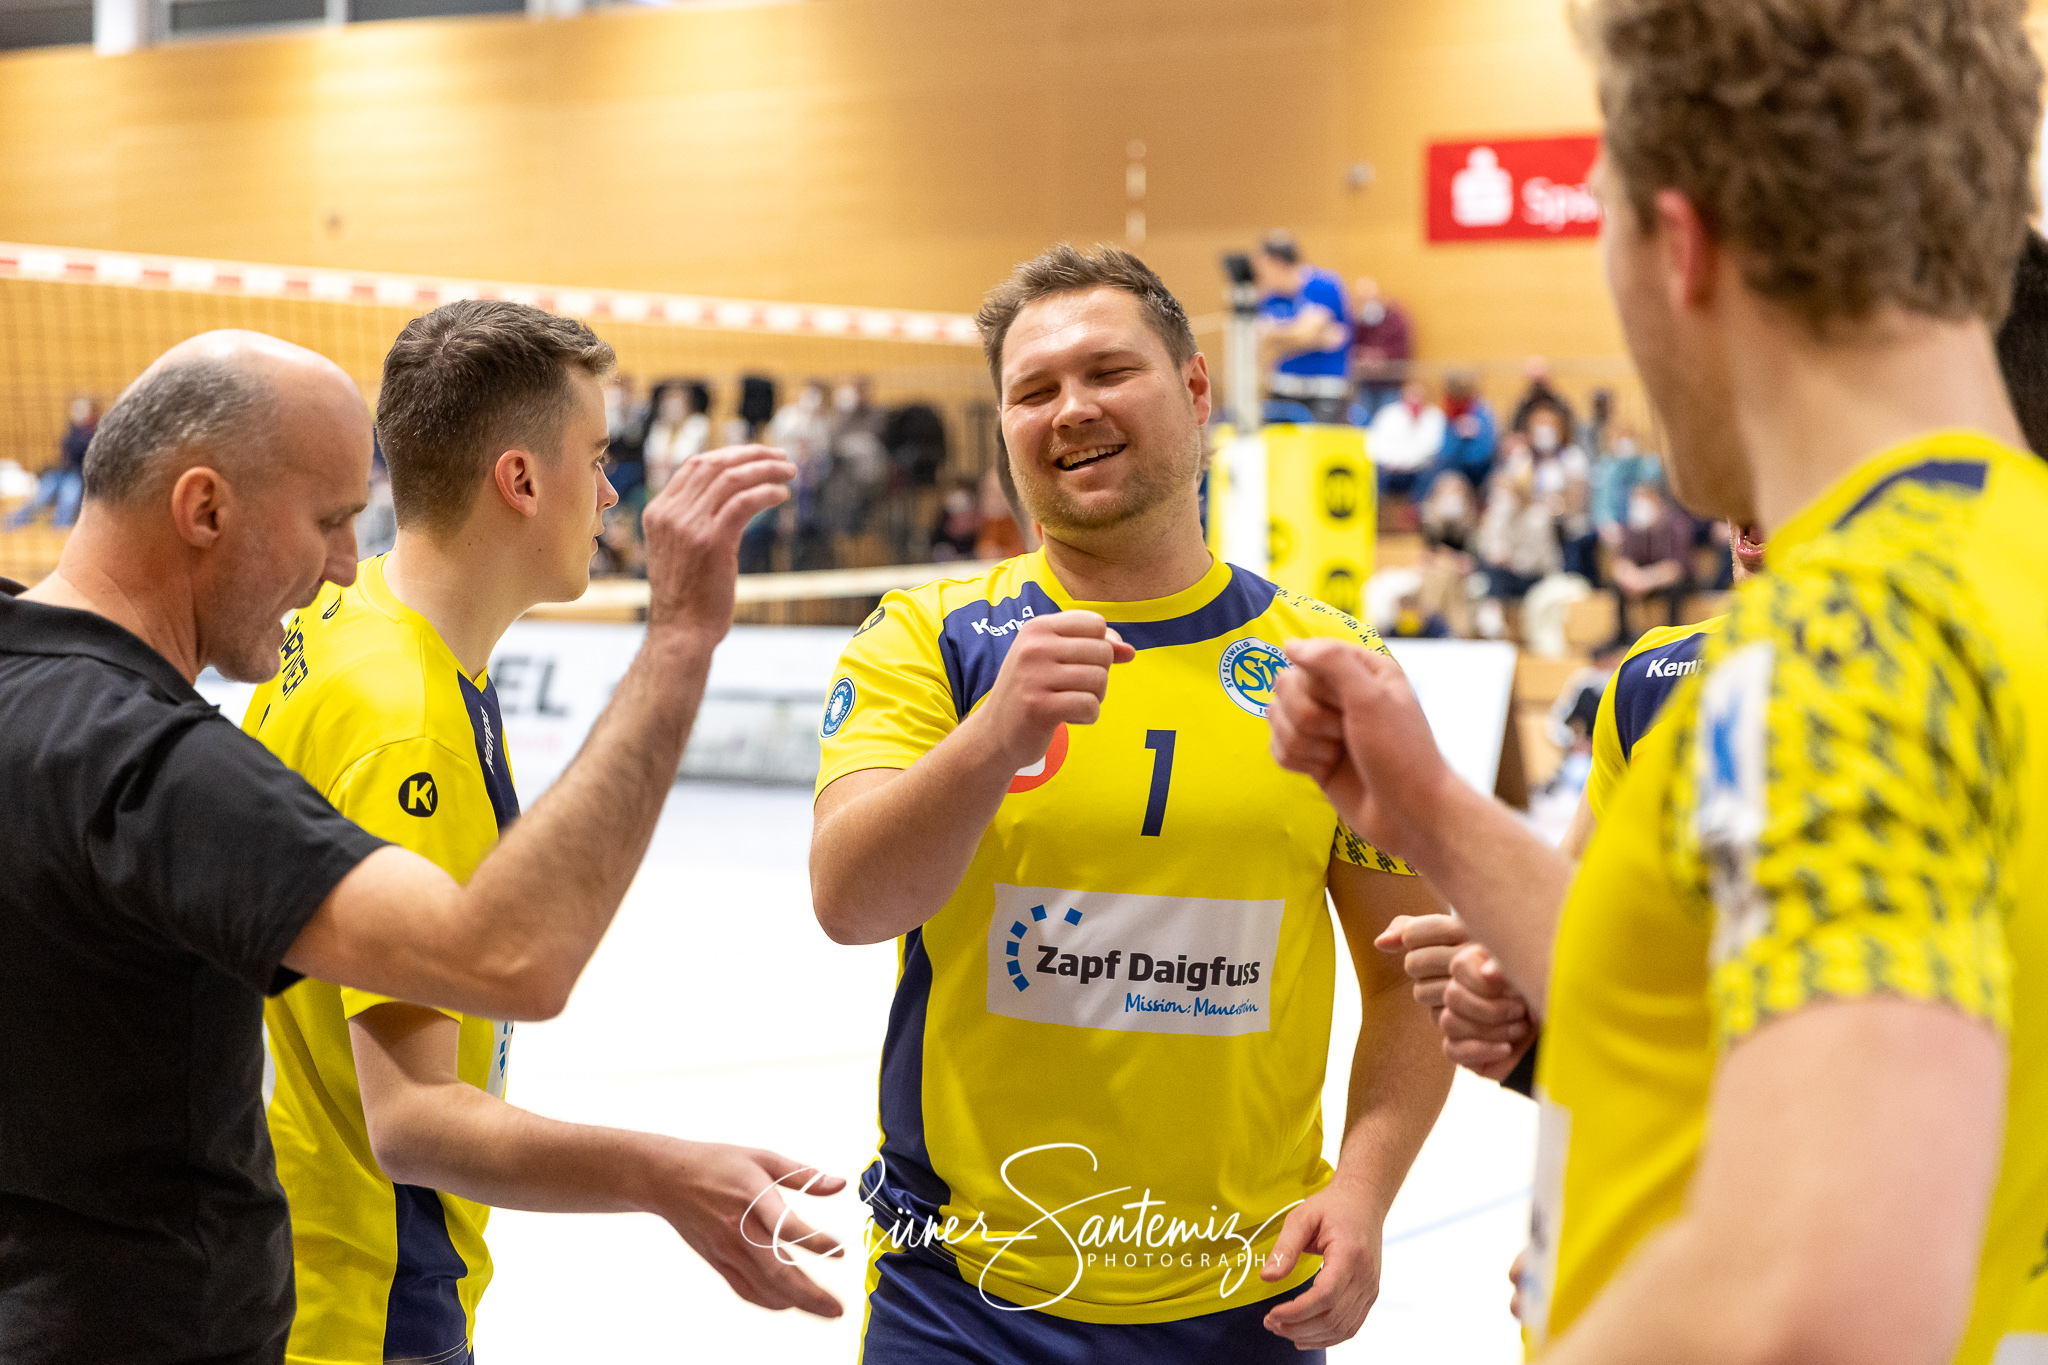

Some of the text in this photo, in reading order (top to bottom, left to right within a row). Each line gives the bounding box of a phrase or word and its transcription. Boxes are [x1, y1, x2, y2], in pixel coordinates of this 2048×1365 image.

[1223, 641, 1251, 673] SCHWAIG
[1140, 729, 1177, 837] 1
[1036, 945, 1261, 992] Zapf Daigfuss
[1124, 992, 1191, 1014] Mission:
